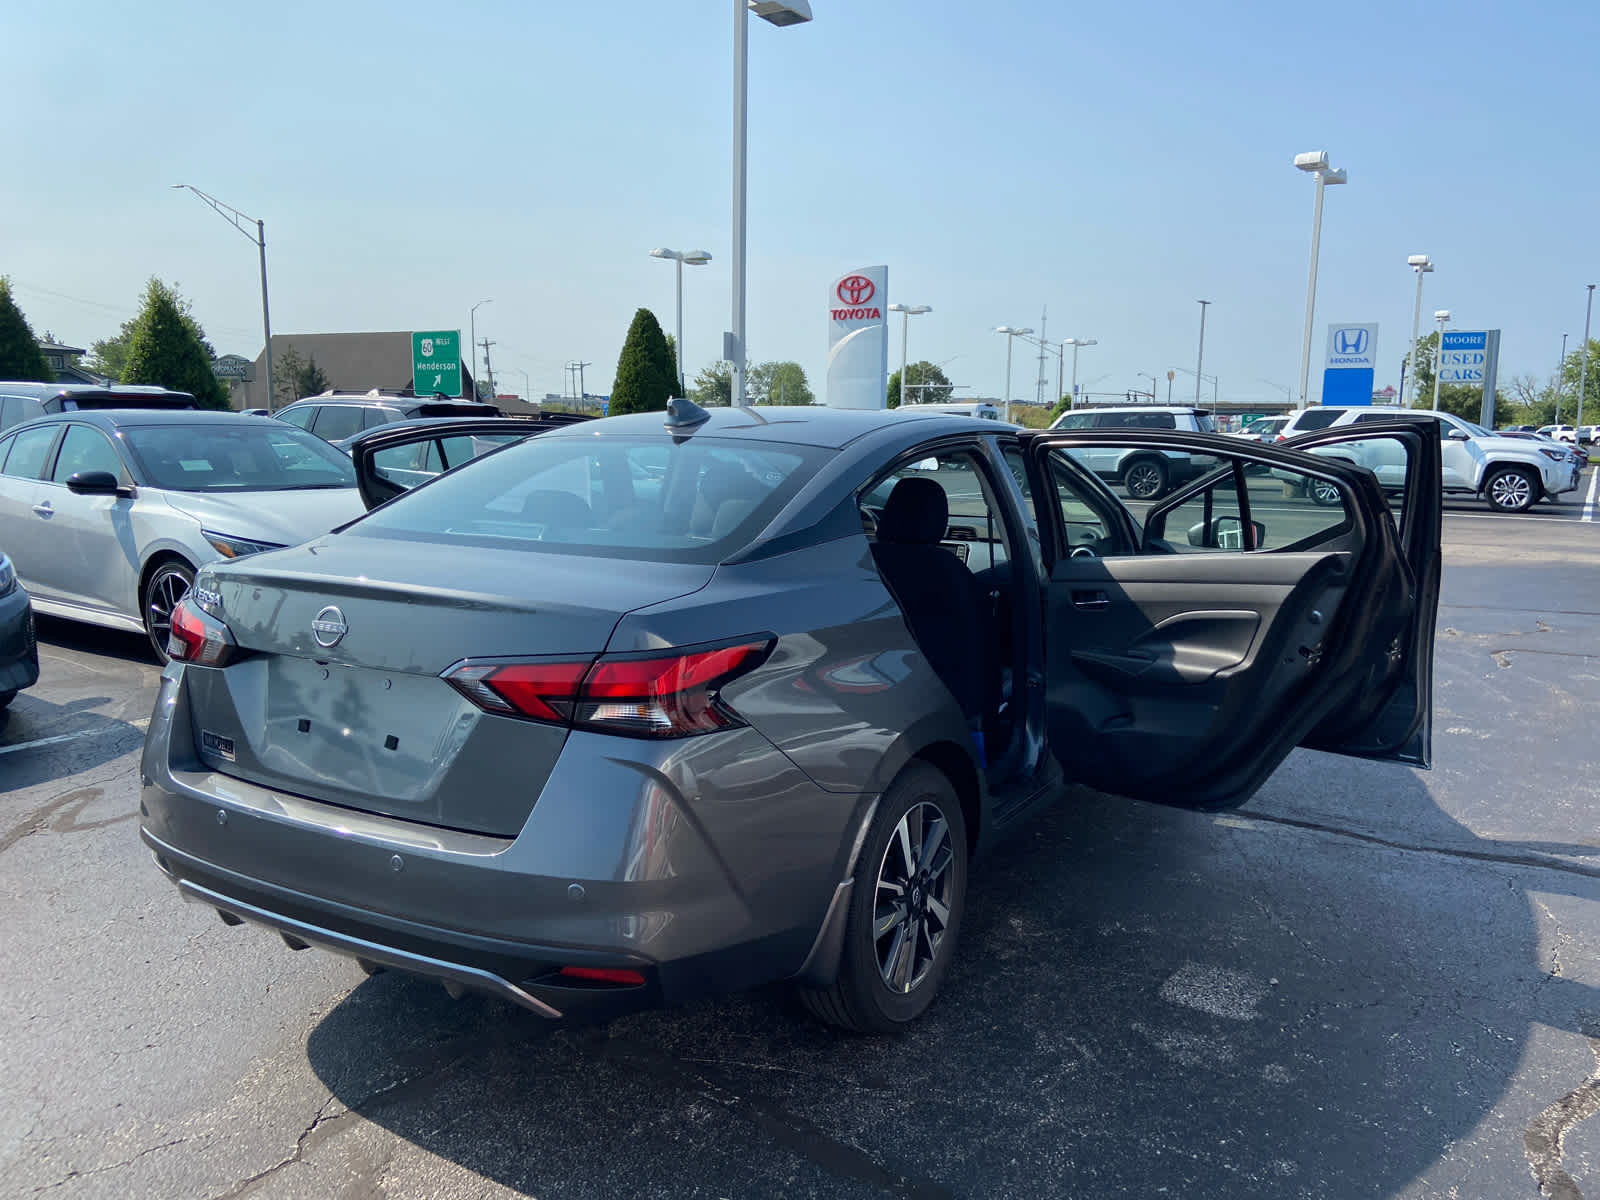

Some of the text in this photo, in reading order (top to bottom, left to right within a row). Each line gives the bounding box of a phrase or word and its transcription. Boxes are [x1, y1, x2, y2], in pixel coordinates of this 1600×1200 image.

[830, 307, 881, 321] TOYOTA
[1444, 335, 1483, 345] MOORE
[422, 342, 432, 353] 60
[1441, 352, 1484, 365] USED
[417, 361, 456, 370] Henderson
[1439, 368, 1483, 380] CARS
[311, 621, 345, 634] NISSAN
